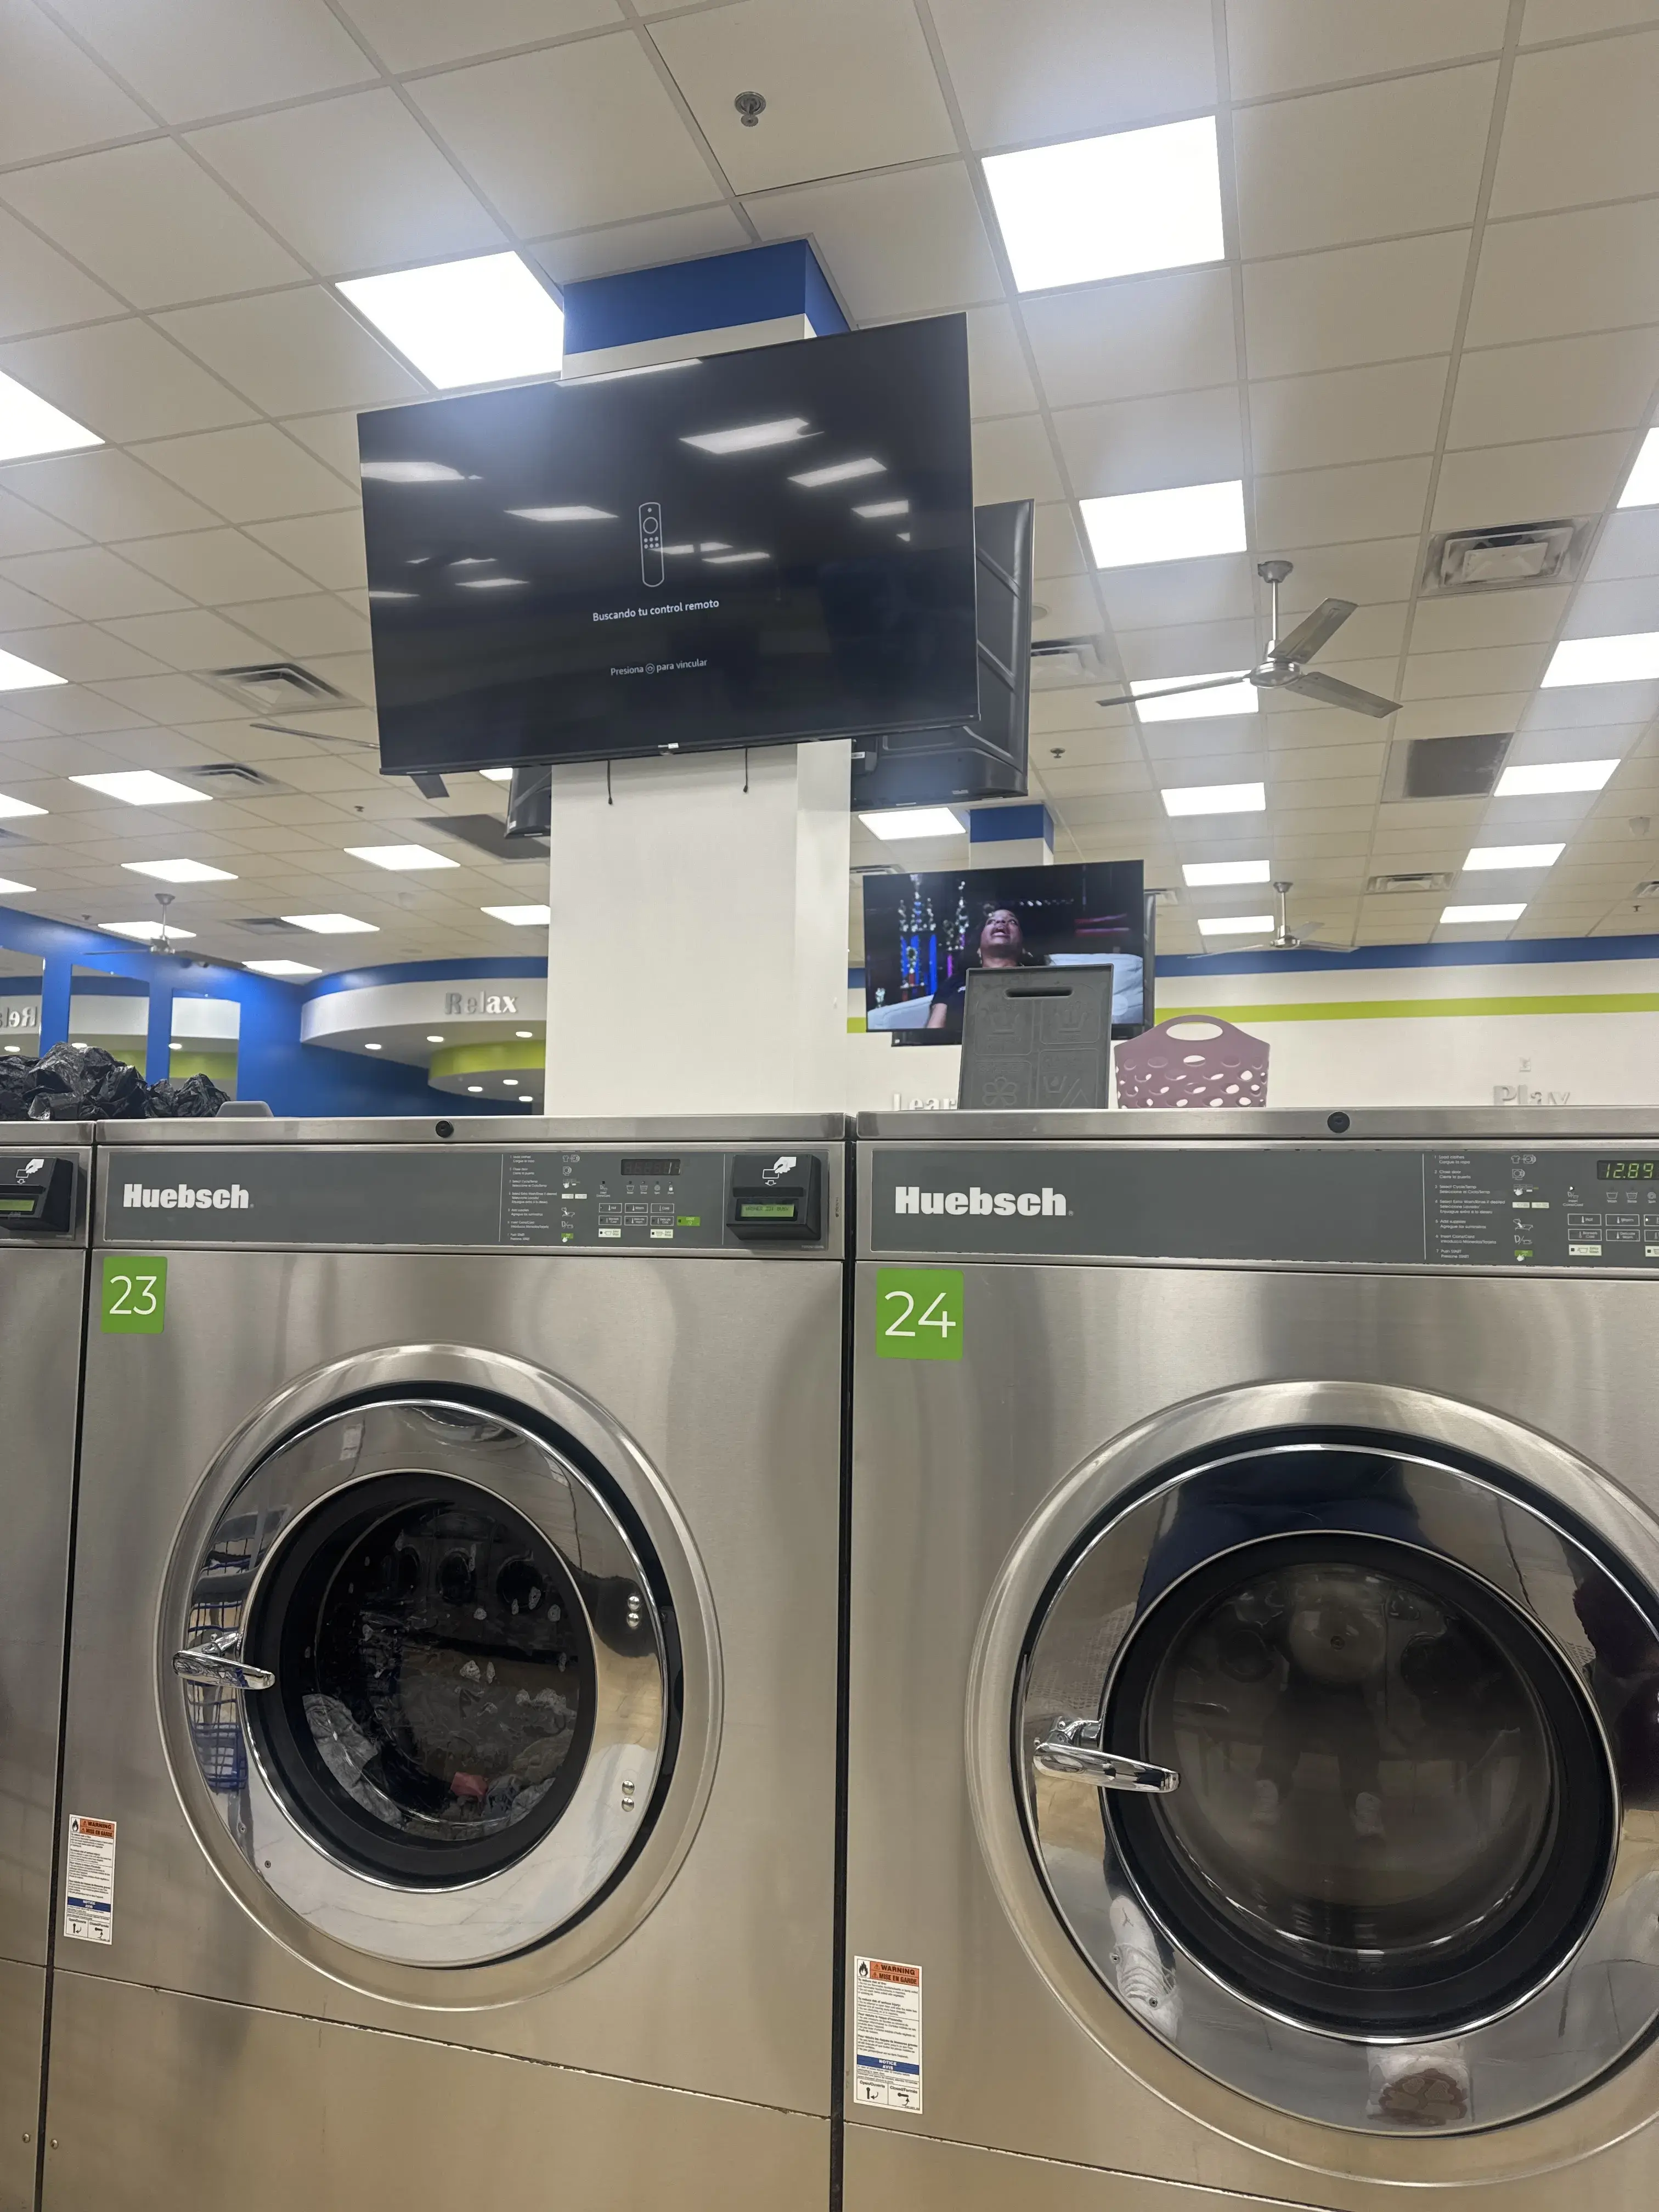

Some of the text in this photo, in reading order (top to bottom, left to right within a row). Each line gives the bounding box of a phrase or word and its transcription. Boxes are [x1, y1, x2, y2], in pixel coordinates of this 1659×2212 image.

[592, 599, 719, 621] Buscando tu control remoto
[610, 658, 708, 676] Presiona para vincular
[444, 990, 516, 1014] Relax
[1606, 1163, 1654, 1178] 12.89
[123, 1183, 249, 1209] Huebsch
[895, 1186, 1066, 1216] Huebsch
[109, 1276, 157, 1315] 23
[884, 1291, 956, 1338] 24
[87, 1821, 112, 1830] WARNING
[881, 1964, 915, 1975] WARNING
[900, 1977, 917, 1985] GARDE
